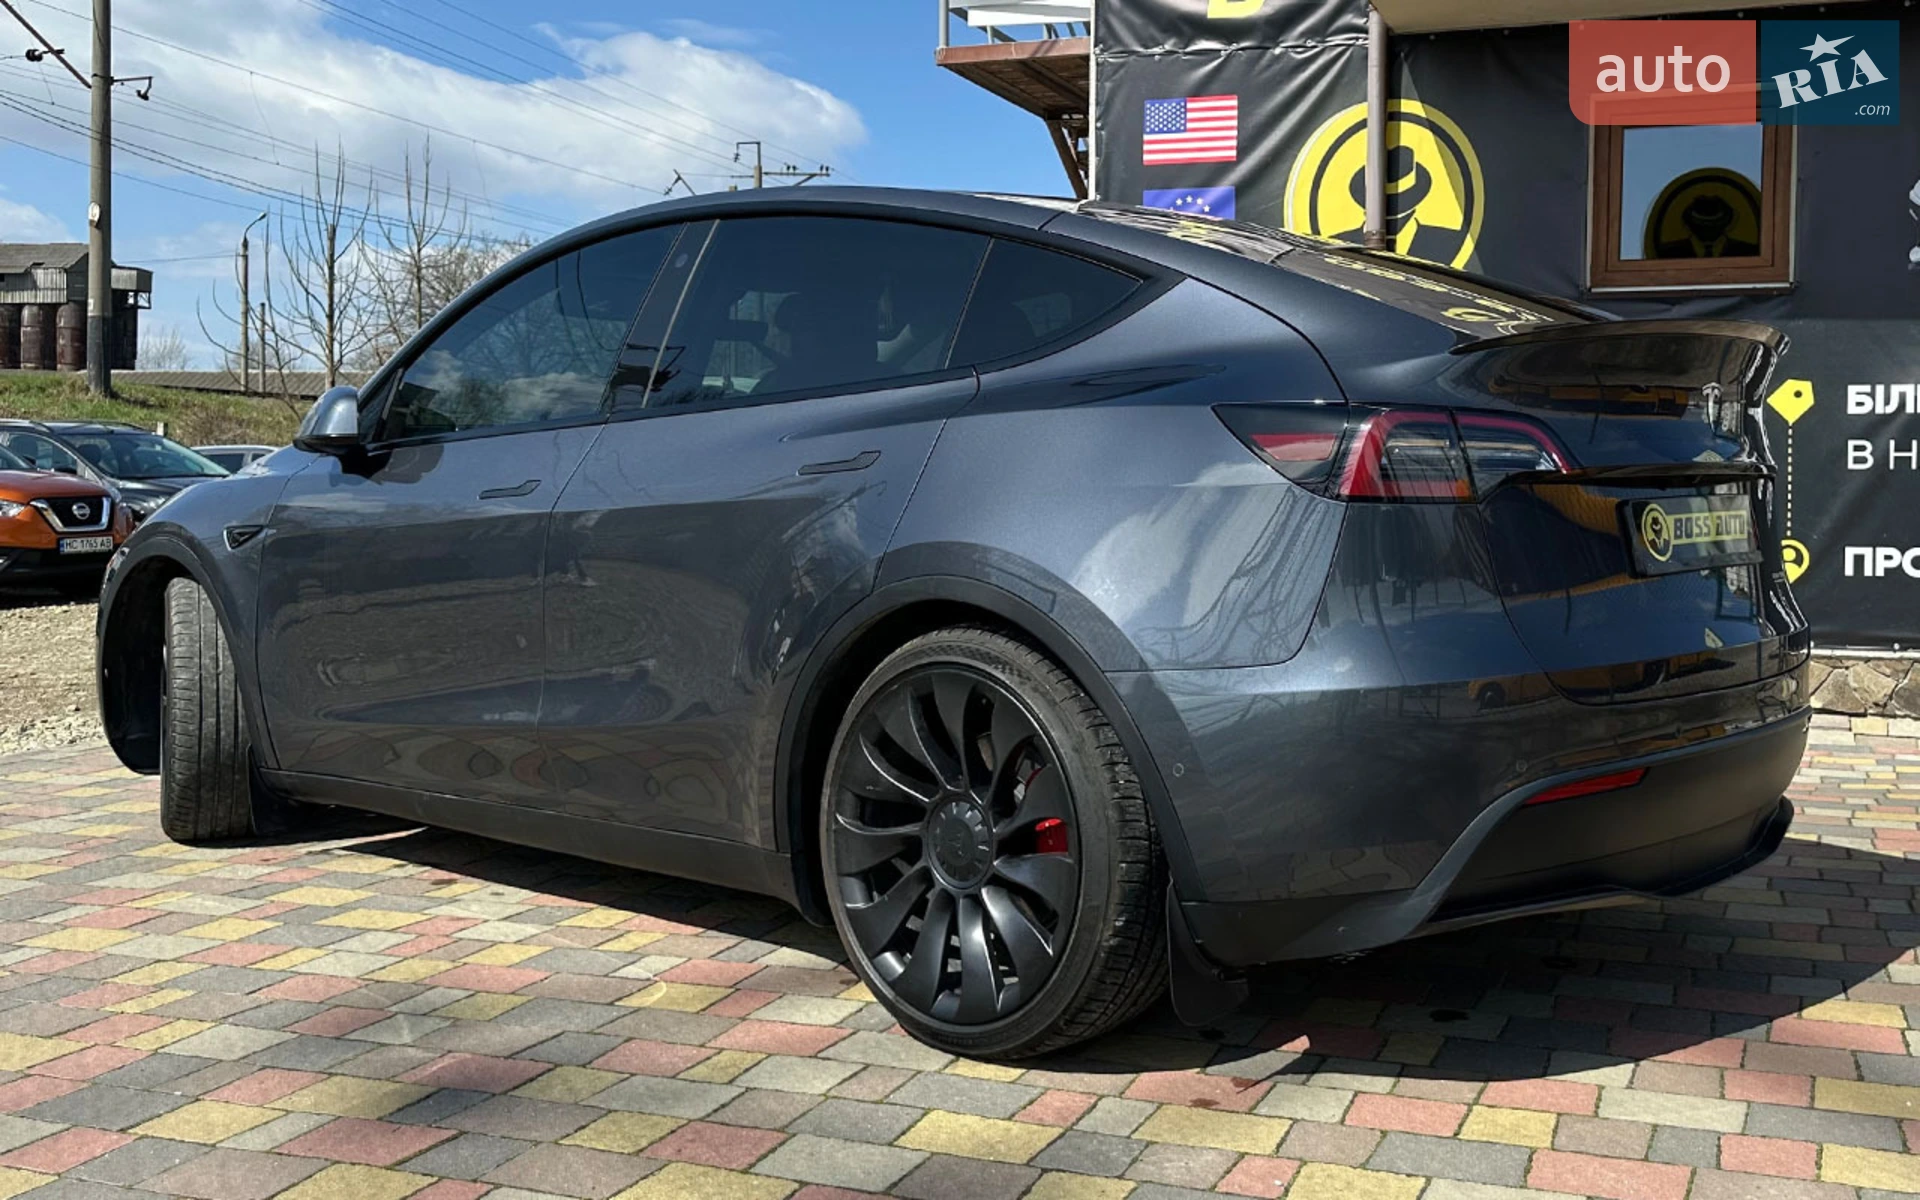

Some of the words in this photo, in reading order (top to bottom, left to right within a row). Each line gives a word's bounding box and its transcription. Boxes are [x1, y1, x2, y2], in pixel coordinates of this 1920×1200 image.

[1847, 384, 1920, 414] БІЛ
[1673, 516, 1711, 540] BOSS
[1716, 514, 1745, 536] AUTO
